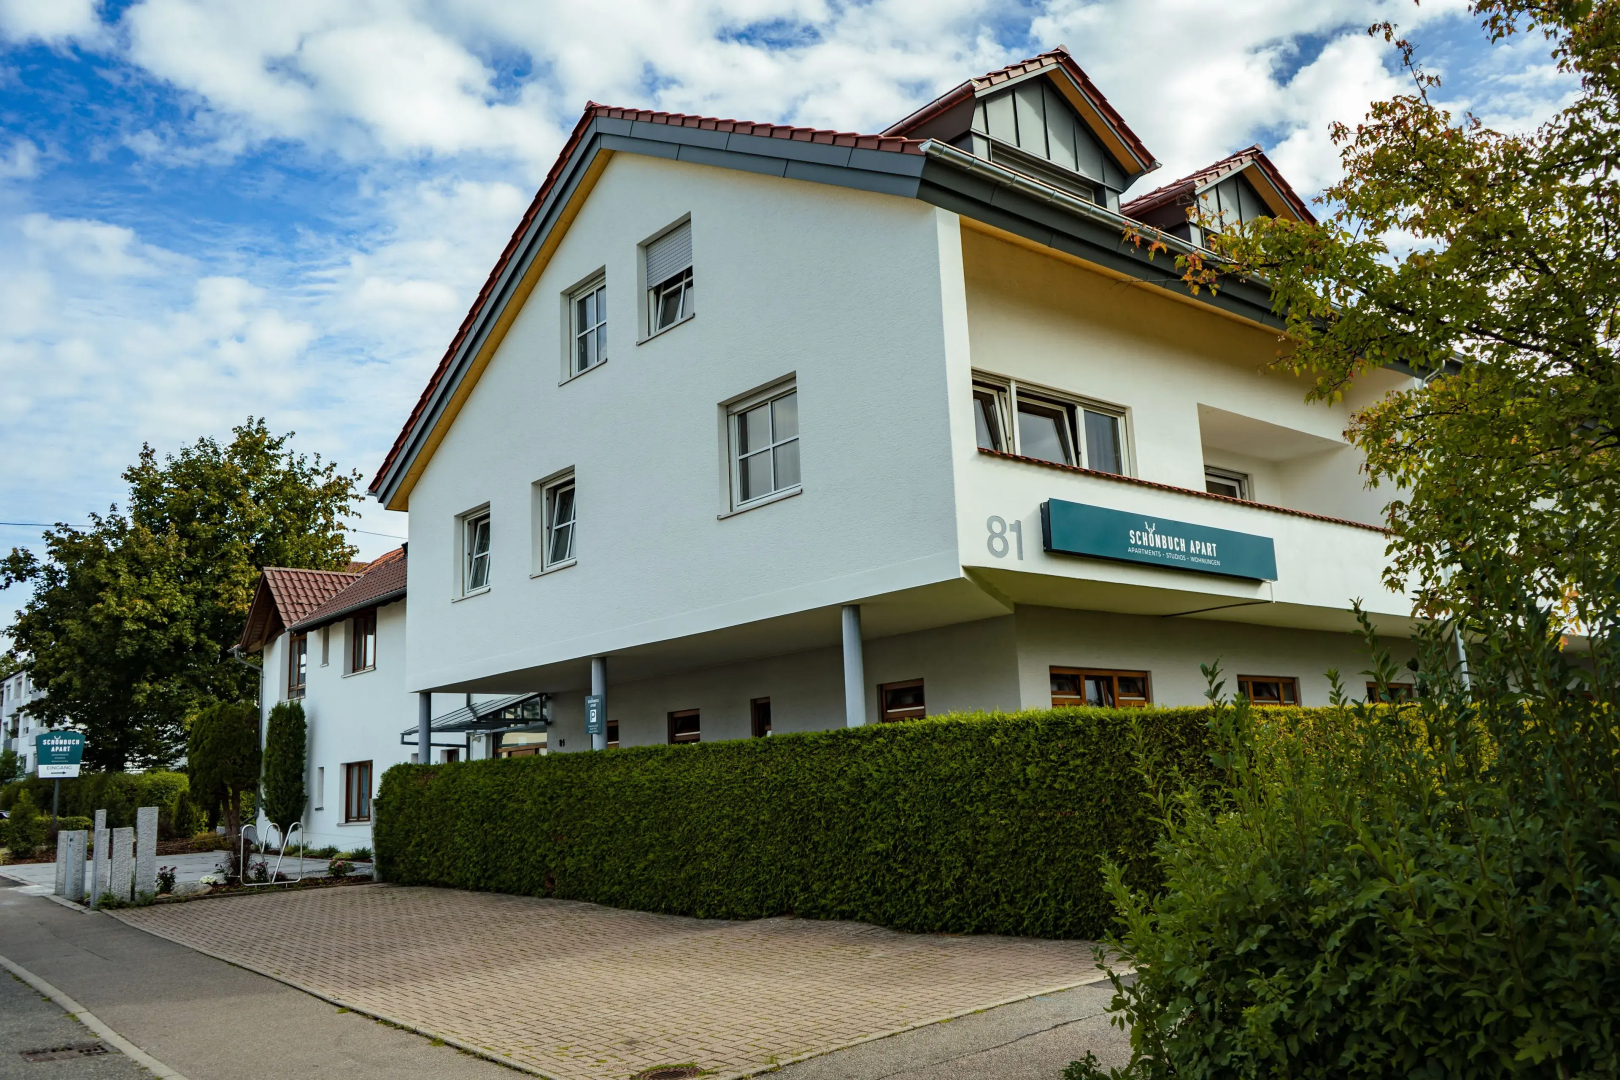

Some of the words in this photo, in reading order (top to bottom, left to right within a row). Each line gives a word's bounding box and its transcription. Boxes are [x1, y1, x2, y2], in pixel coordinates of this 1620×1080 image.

[986, 515, 1024, 560] 81
[1127, 546, 1162, 557] APARTMENTS
[1165, 552, 1187, 561] STUDIOS
[1190, 556, 1221, 566] WOHNUNGEN
[1190, 539, 1217, 557] APART
